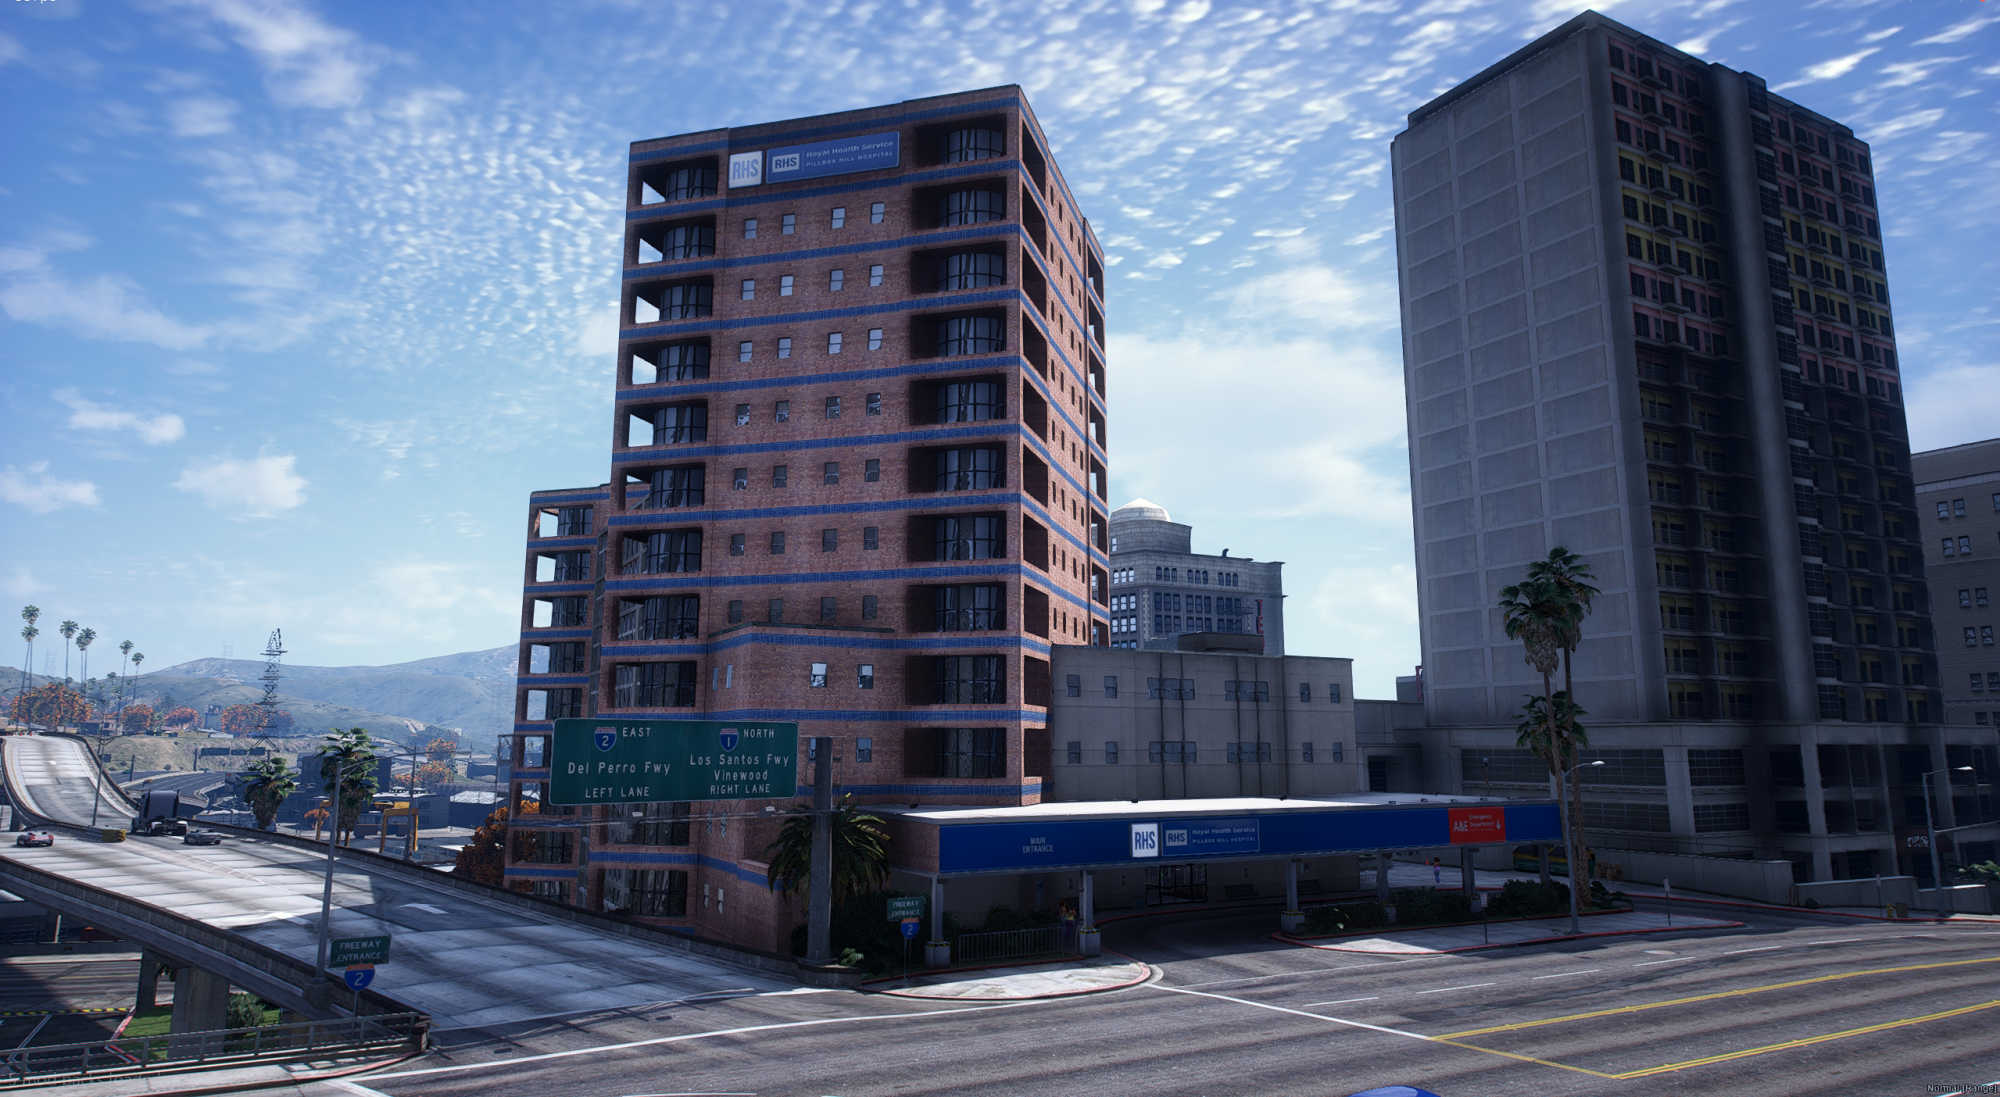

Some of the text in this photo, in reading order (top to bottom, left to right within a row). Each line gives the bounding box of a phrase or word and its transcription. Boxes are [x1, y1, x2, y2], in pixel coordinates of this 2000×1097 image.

[806, 141, 894, 158] Royal Health Service
[775, 157, 797, 169] RHS
[732, 159, 758, 180] RHS
[622, 727, 651, 738] EAST
[743, 728, 774, 739] NORTH
[602, 735, 609, 747] 2
[727, 737, 731, 748] 1
[689, 753, 789, 766] Los Santos Fwy
[568, 762, 671, 776] Del Perro Fwy
[714, 770, 768, 781] Vinewood
[585, 787, 650, 798] LEFT LANE
[710, 784, 771, 795] RIGHT LANE
[1453, 820, 1469, 832] A&E
[1134, 832, 1156, 850] RHS
[1167, 833, 1186, 843] RHS
[1022, 844, 1054, 854] ENTRANCE
[892, 900, 919, 908] FREEWAY
[892, 909, 920, 917] ENTRANCE
[907, 924, 913, 935] 2
[340, 940, 381, 950] FREEWAY
[337, 952, 382, 962] ENTRANCE
[354, 972, 364, 986] 2
